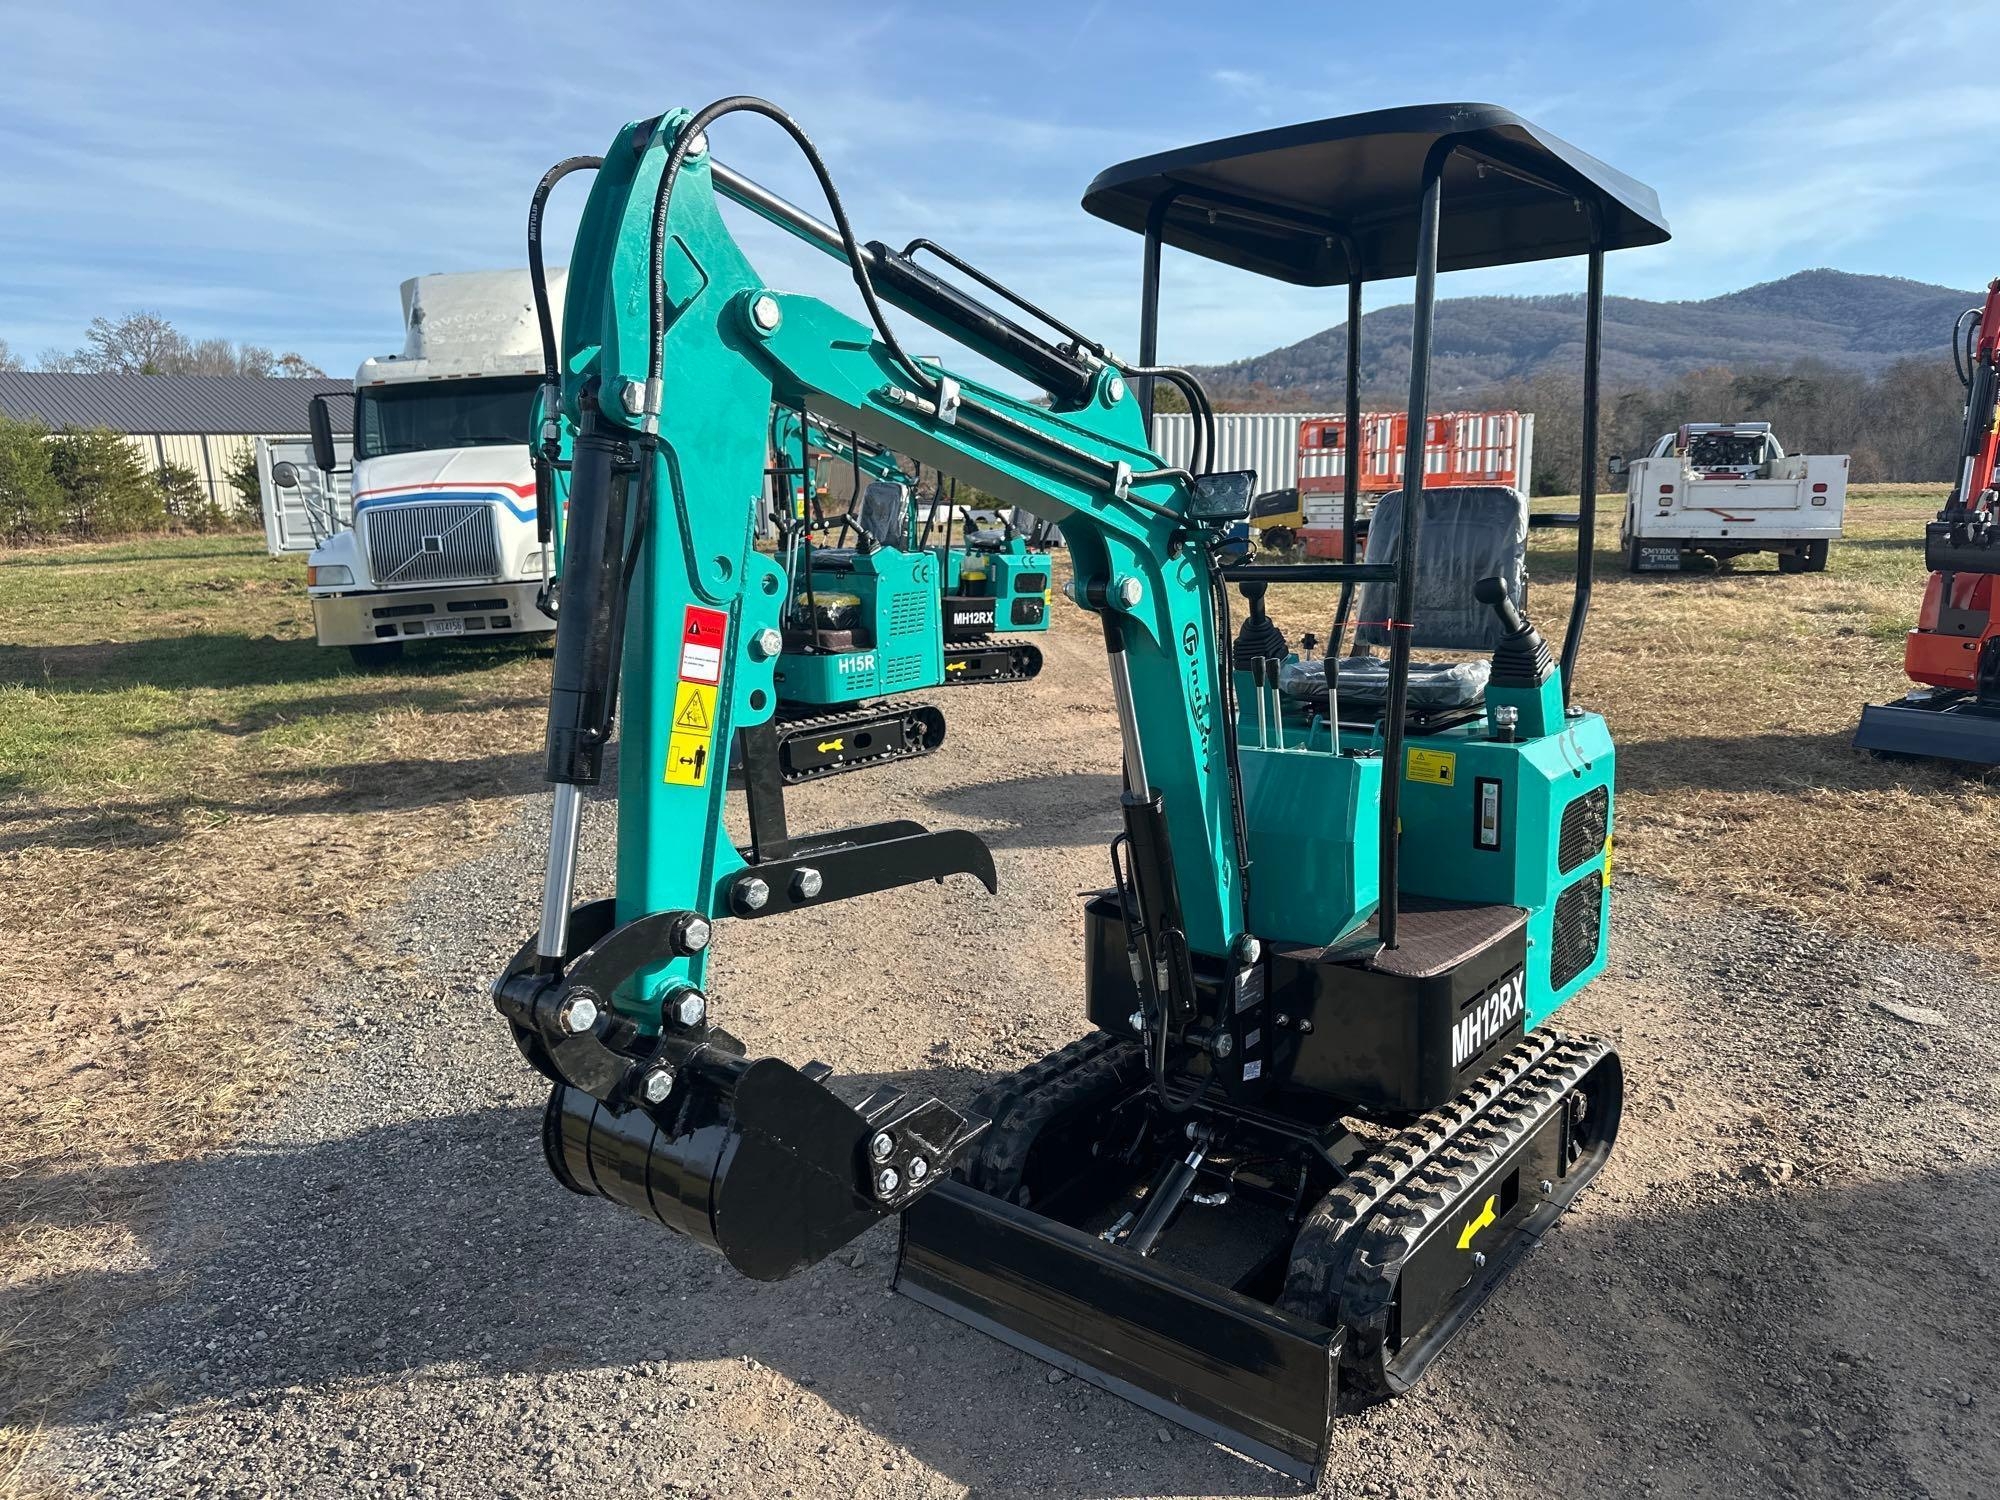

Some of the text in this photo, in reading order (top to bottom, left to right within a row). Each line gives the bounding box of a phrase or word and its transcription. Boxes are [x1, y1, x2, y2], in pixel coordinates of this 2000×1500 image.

[1641, 547, 1678, 557] SMYRNA
[1649, 554, 1680, 563] TRUCK
[953, 611, 994, 625] MH12RX
[838, 654, 876, 675] H15R
[1451, 969, 1525, 1068] MH12RX
